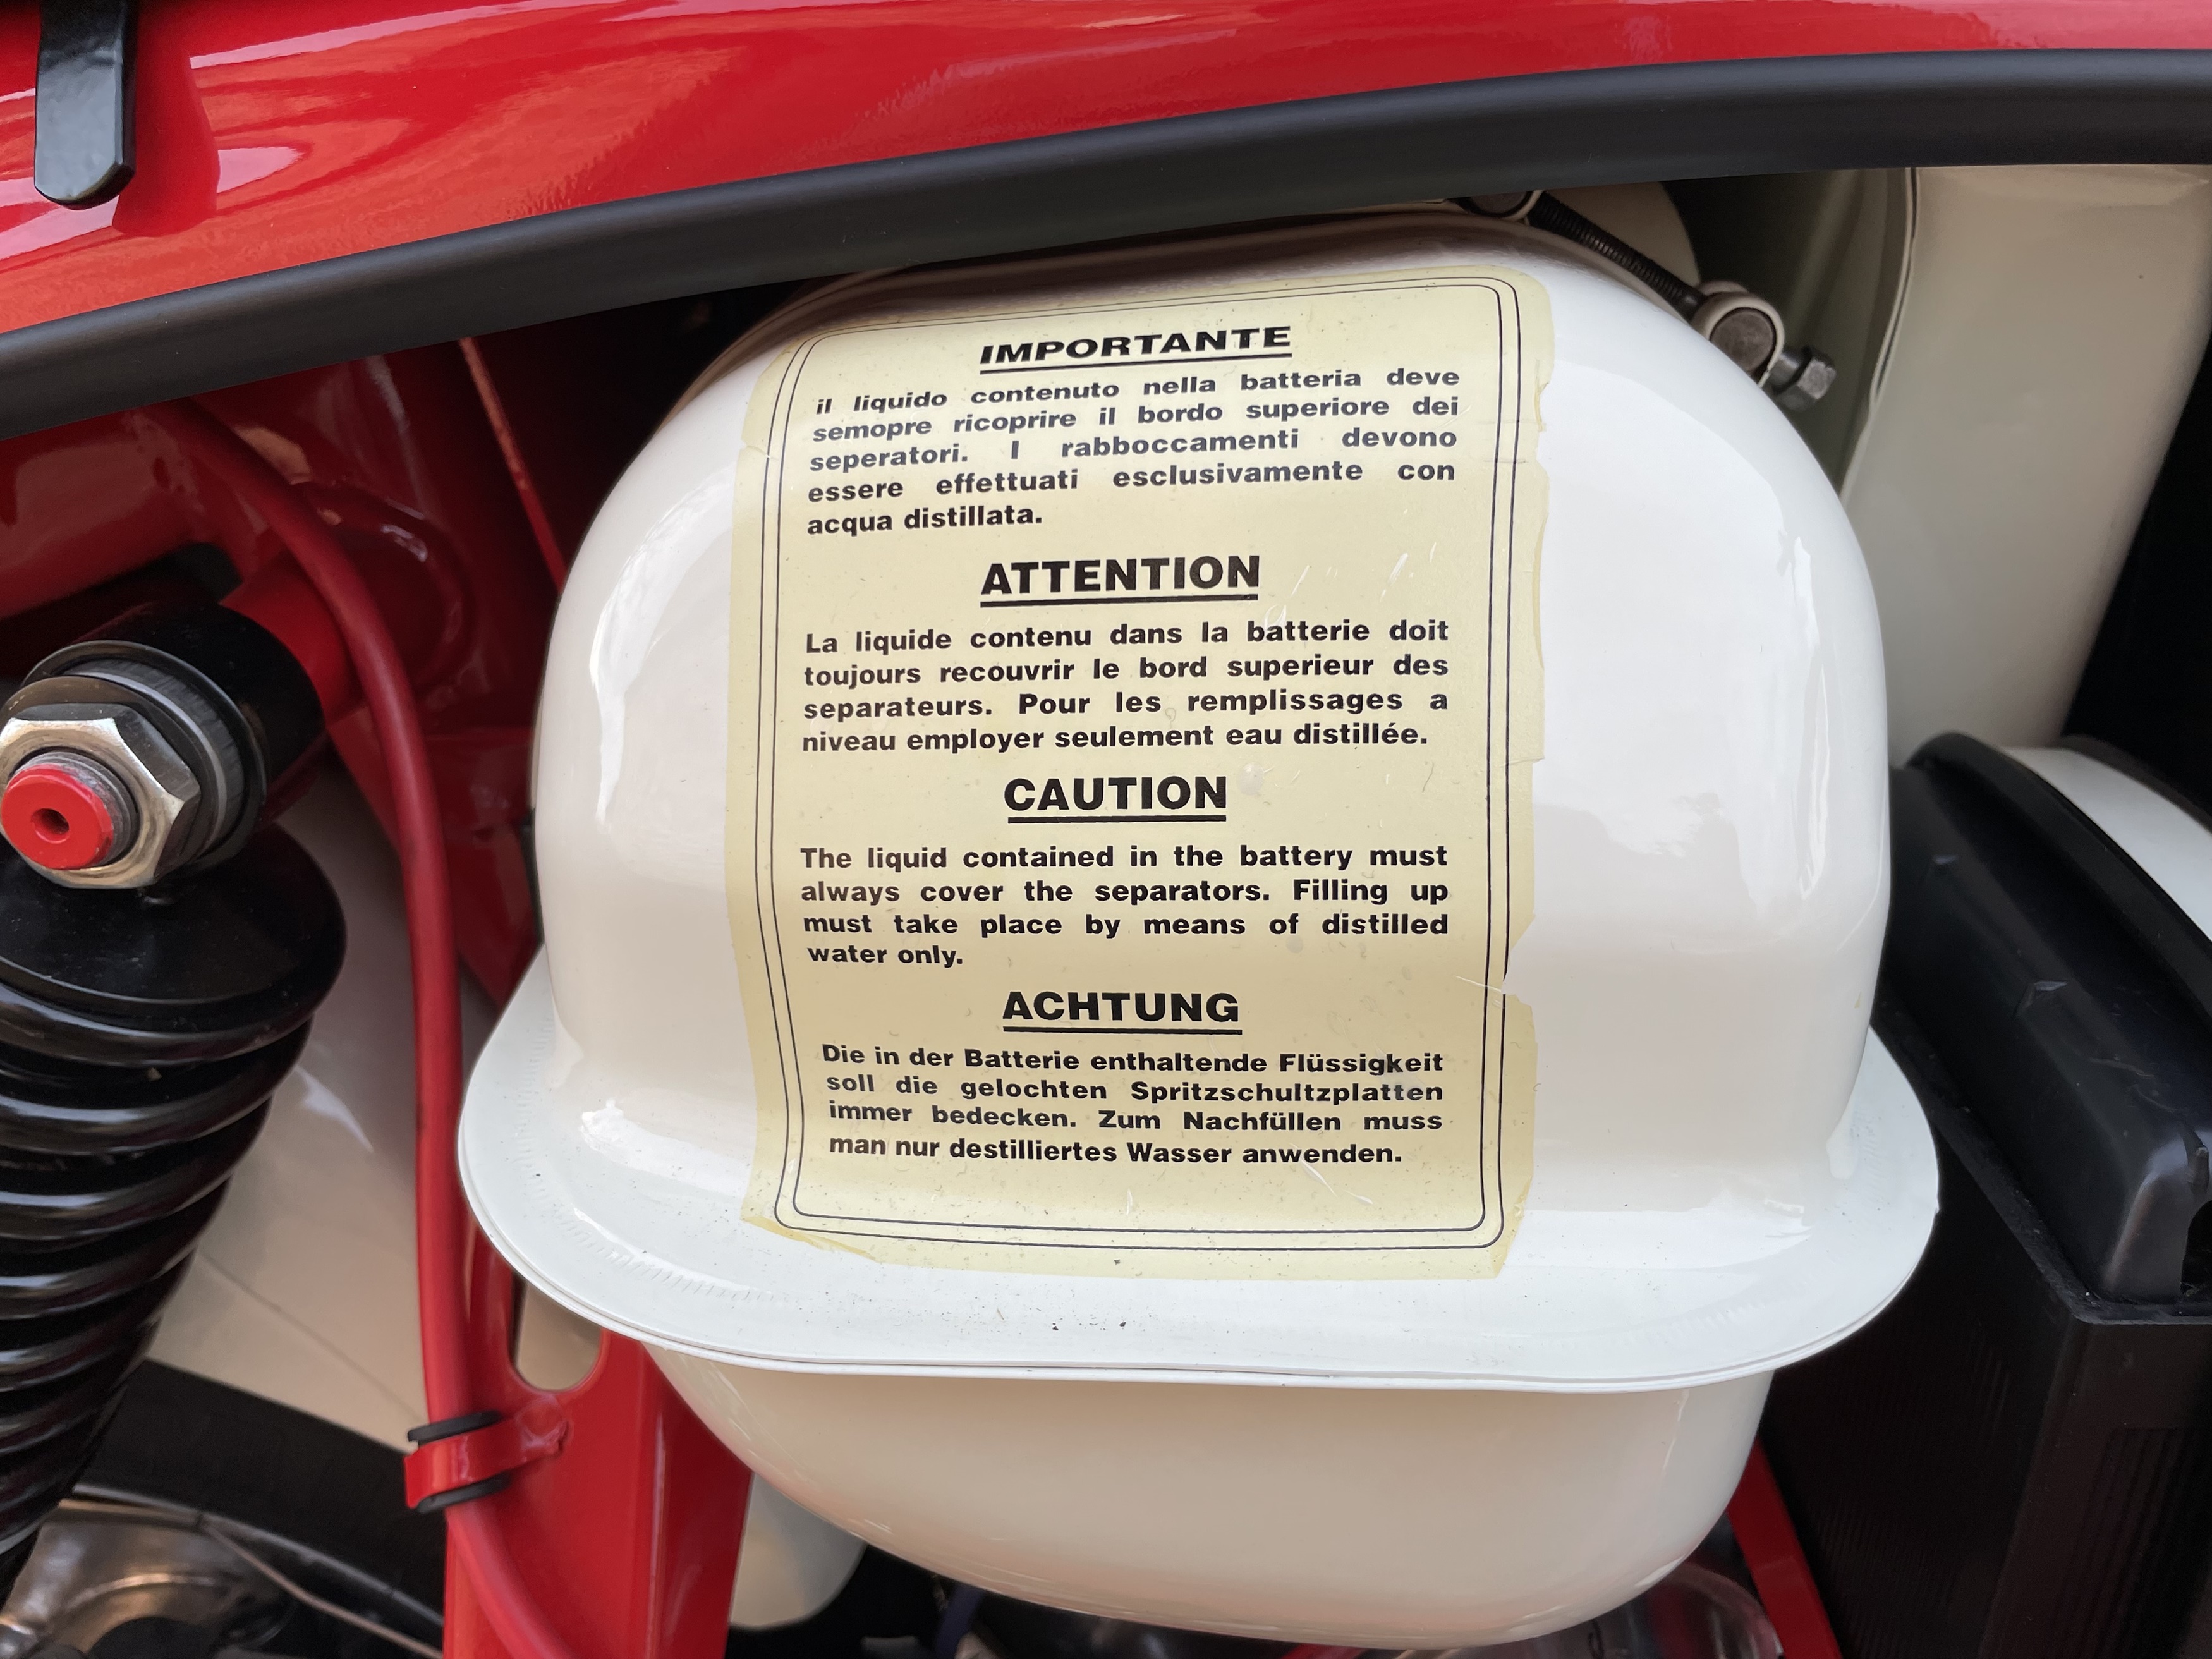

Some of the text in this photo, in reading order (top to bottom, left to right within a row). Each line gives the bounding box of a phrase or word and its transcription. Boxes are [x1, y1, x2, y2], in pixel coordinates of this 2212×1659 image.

[980, 325, 1291, 365] IMPORTANTE
[816, 367, 1460, 415] il liquido contenuto nella batteria deve
[813, 396, 1459, 442] semopre ricoprire il bordo superiore dei
[810, 427, 1457, 473] seperatori. I rabboccamenti devono
[808, 461, 1455, 503] essere effettuati esclusivamente con
[807, 504, 1042, 537] acqua distillata.
[980, 555, 1260, 595] ATTENTION
[806, 619, 1449, 656] La liquide contenu dans la batterie doit
[804, 653, 1449, 690] toujours recouvrir le bord superieur des
[804, 688, 1448, 723] separateurs. Pour les remplissages a
[803, 722, 1427, 755] niveau employer seulement eau distillée.
[1004, 775, 1227, 811] CAUTION
[800, 844, 1447, 873] The liquid contained in the battery must
[801, 878, 1449, 906] always cover the separators. Filling up
[803, 912, 1448, 939] must take place by means of distilled
[806, 945, 963, 968] water only.
[1002, 991, 1239, 1023] ACHTUNG
[822, 1043, 1443, 1076] Die in der Batterie enthaltende Flüssigkeit
[827, 1074, 1443, 1106] soll die gelochten Spritzschultzplatten
[829, 1100, 1442, 1131] immer bedecken. Zum Nachfüllen muss
[829, 1138, 1402, 1164] man nur destilliertes Wasser anwenden.
